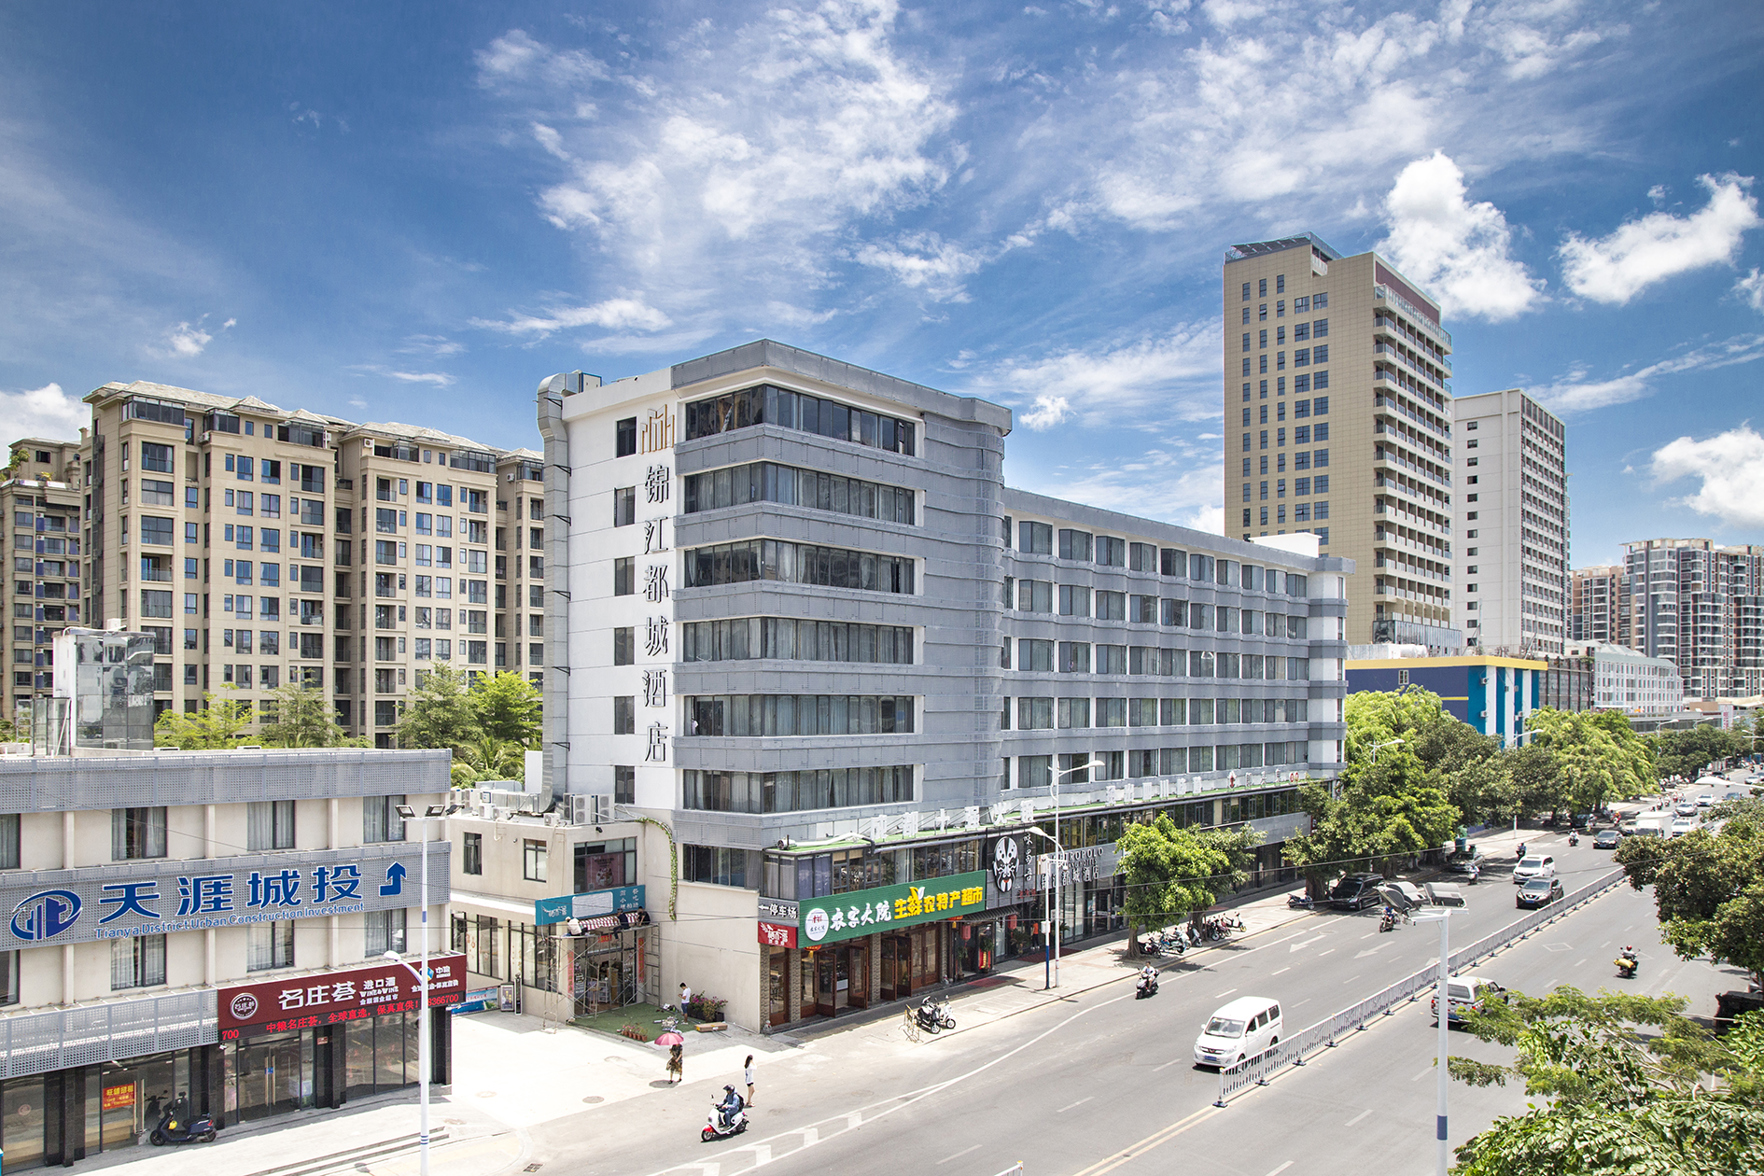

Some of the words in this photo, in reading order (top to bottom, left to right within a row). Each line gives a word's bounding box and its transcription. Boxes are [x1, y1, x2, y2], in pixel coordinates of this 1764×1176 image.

[642, 464, 669, 763] 锦江都城酒店
[98, 863, 362, 925] 天涯城投
[95, 926, 139, 941] Tianya
[142, 921, 190, 934] District
[191, 917, 227, 930] Urban
[228, 909, 303, 926] Construction
[304, 902, 364, 918] Investment
[769, 903, 798, 919] 停车场
[278, 981, 357, 1010] 名庄荟
[363, 976, 396, 990] 进口酒
[222, 1029, 239, 1040] 700
